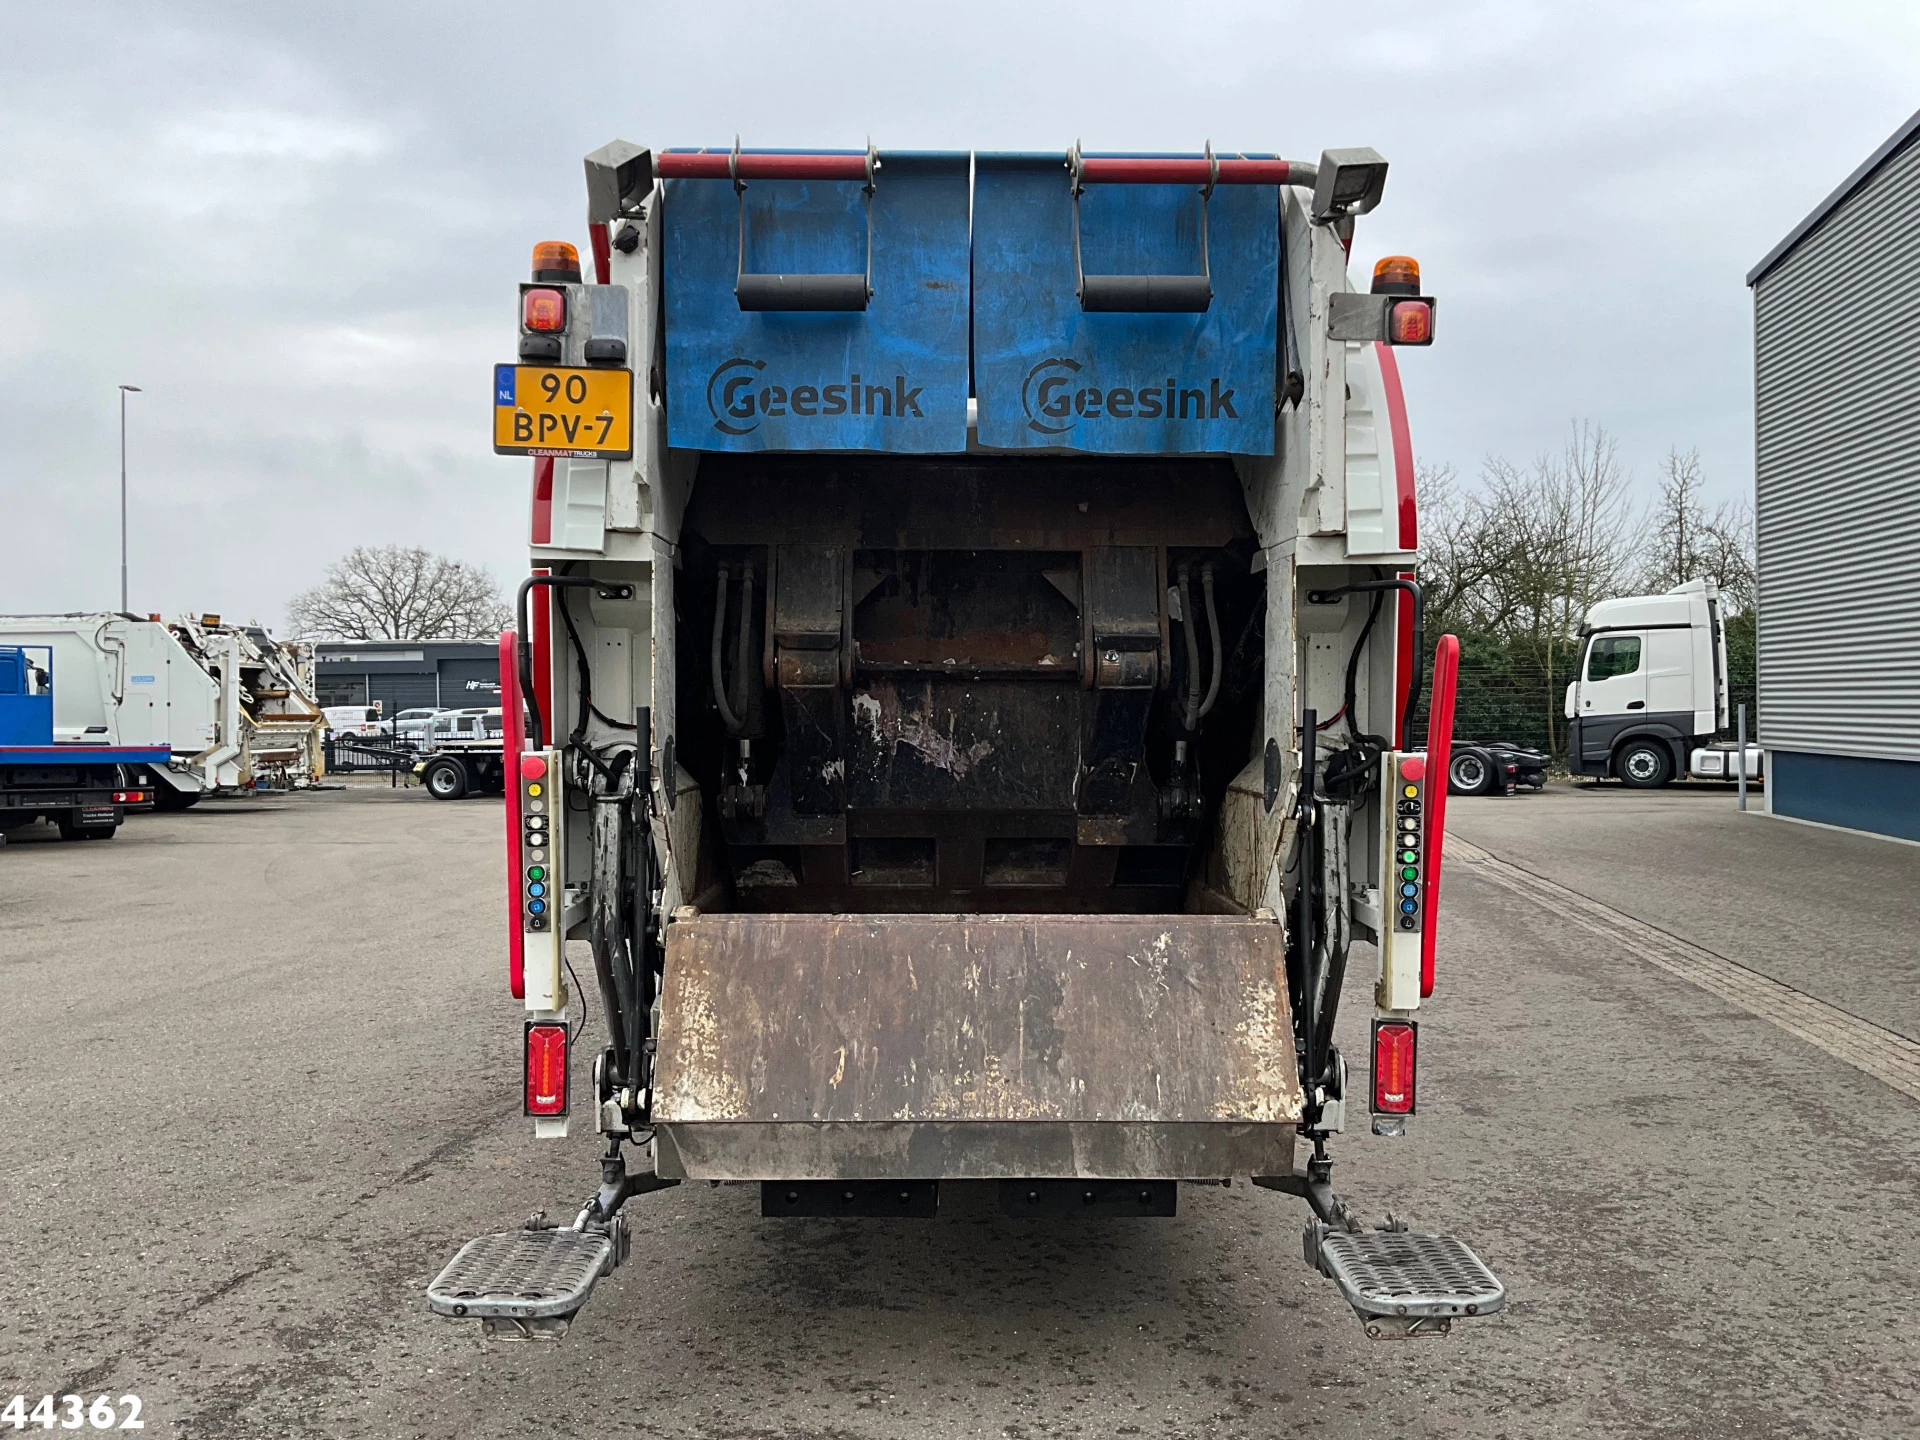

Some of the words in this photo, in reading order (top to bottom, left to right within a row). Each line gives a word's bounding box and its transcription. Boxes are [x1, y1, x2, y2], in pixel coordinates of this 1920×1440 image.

[499, 390, 513, 400] NL
[540, 373, 587, 404] 90
[723, 374, 925, 418] Geesink
[1037, 376, 1240, 420] Geesink
[513, 412, 615, 445] BPV-7
[465, 680, 480, 690] HF
